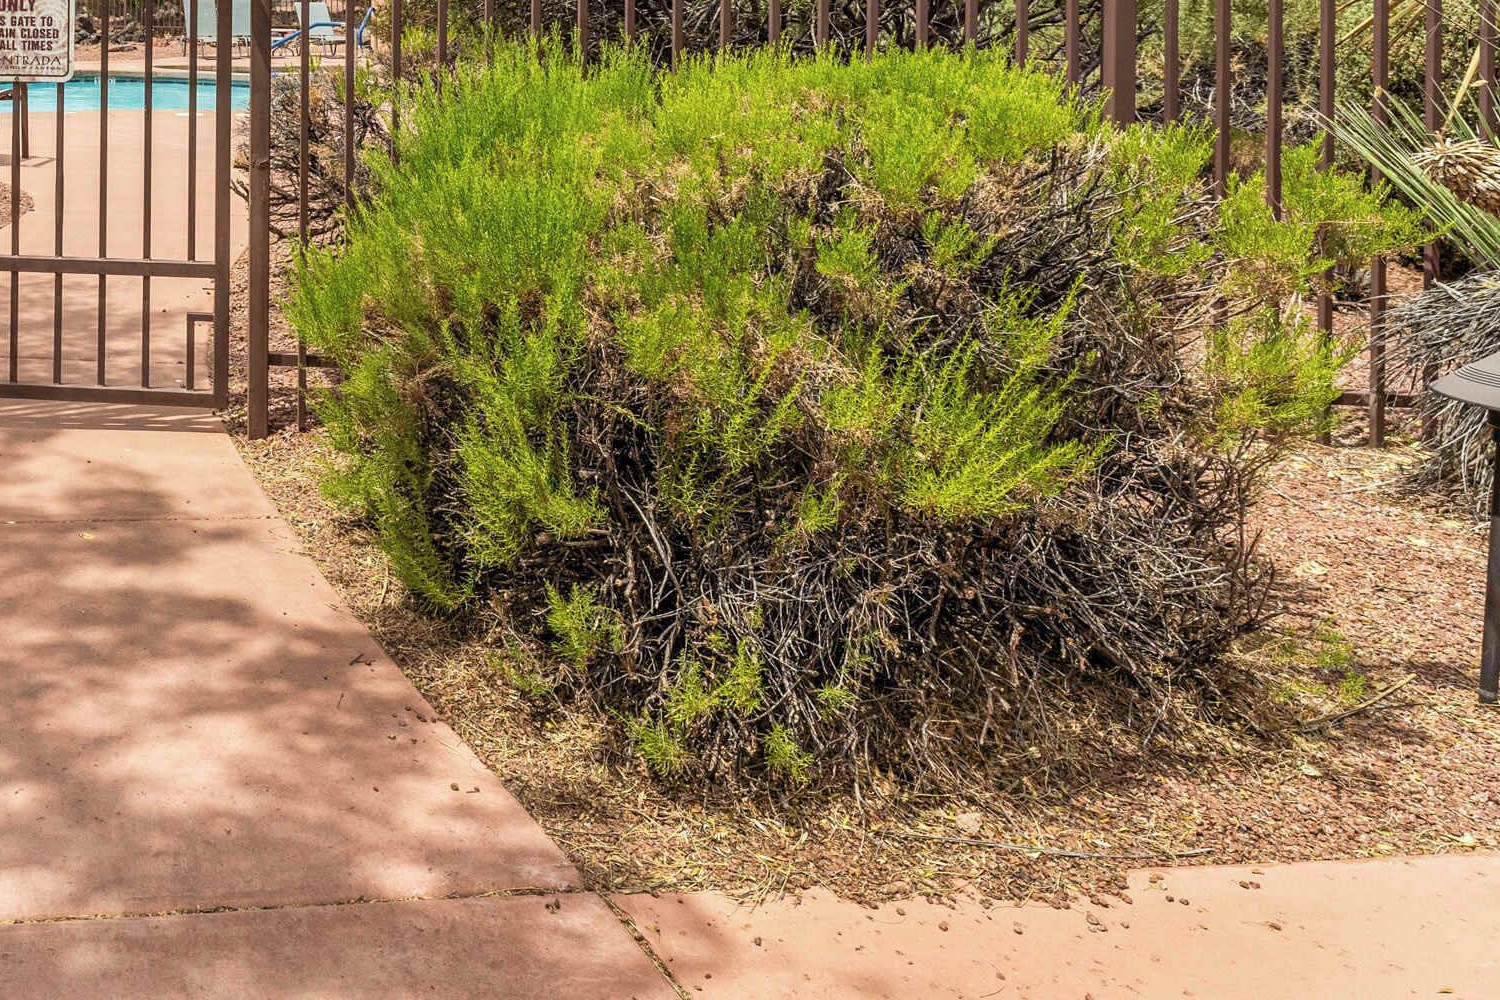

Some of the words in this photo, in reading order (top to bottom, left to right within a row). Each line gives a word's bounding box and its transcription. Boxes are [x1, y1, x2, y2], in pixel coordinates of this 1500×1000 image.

[10, 16, 36, 27] GATE
[41, 16, 53, 27] TO
[20, 28, 59, 39] CLOSED
[0, 40, 17, 51] ALL
[21, 40, 53, 51] TIMES
